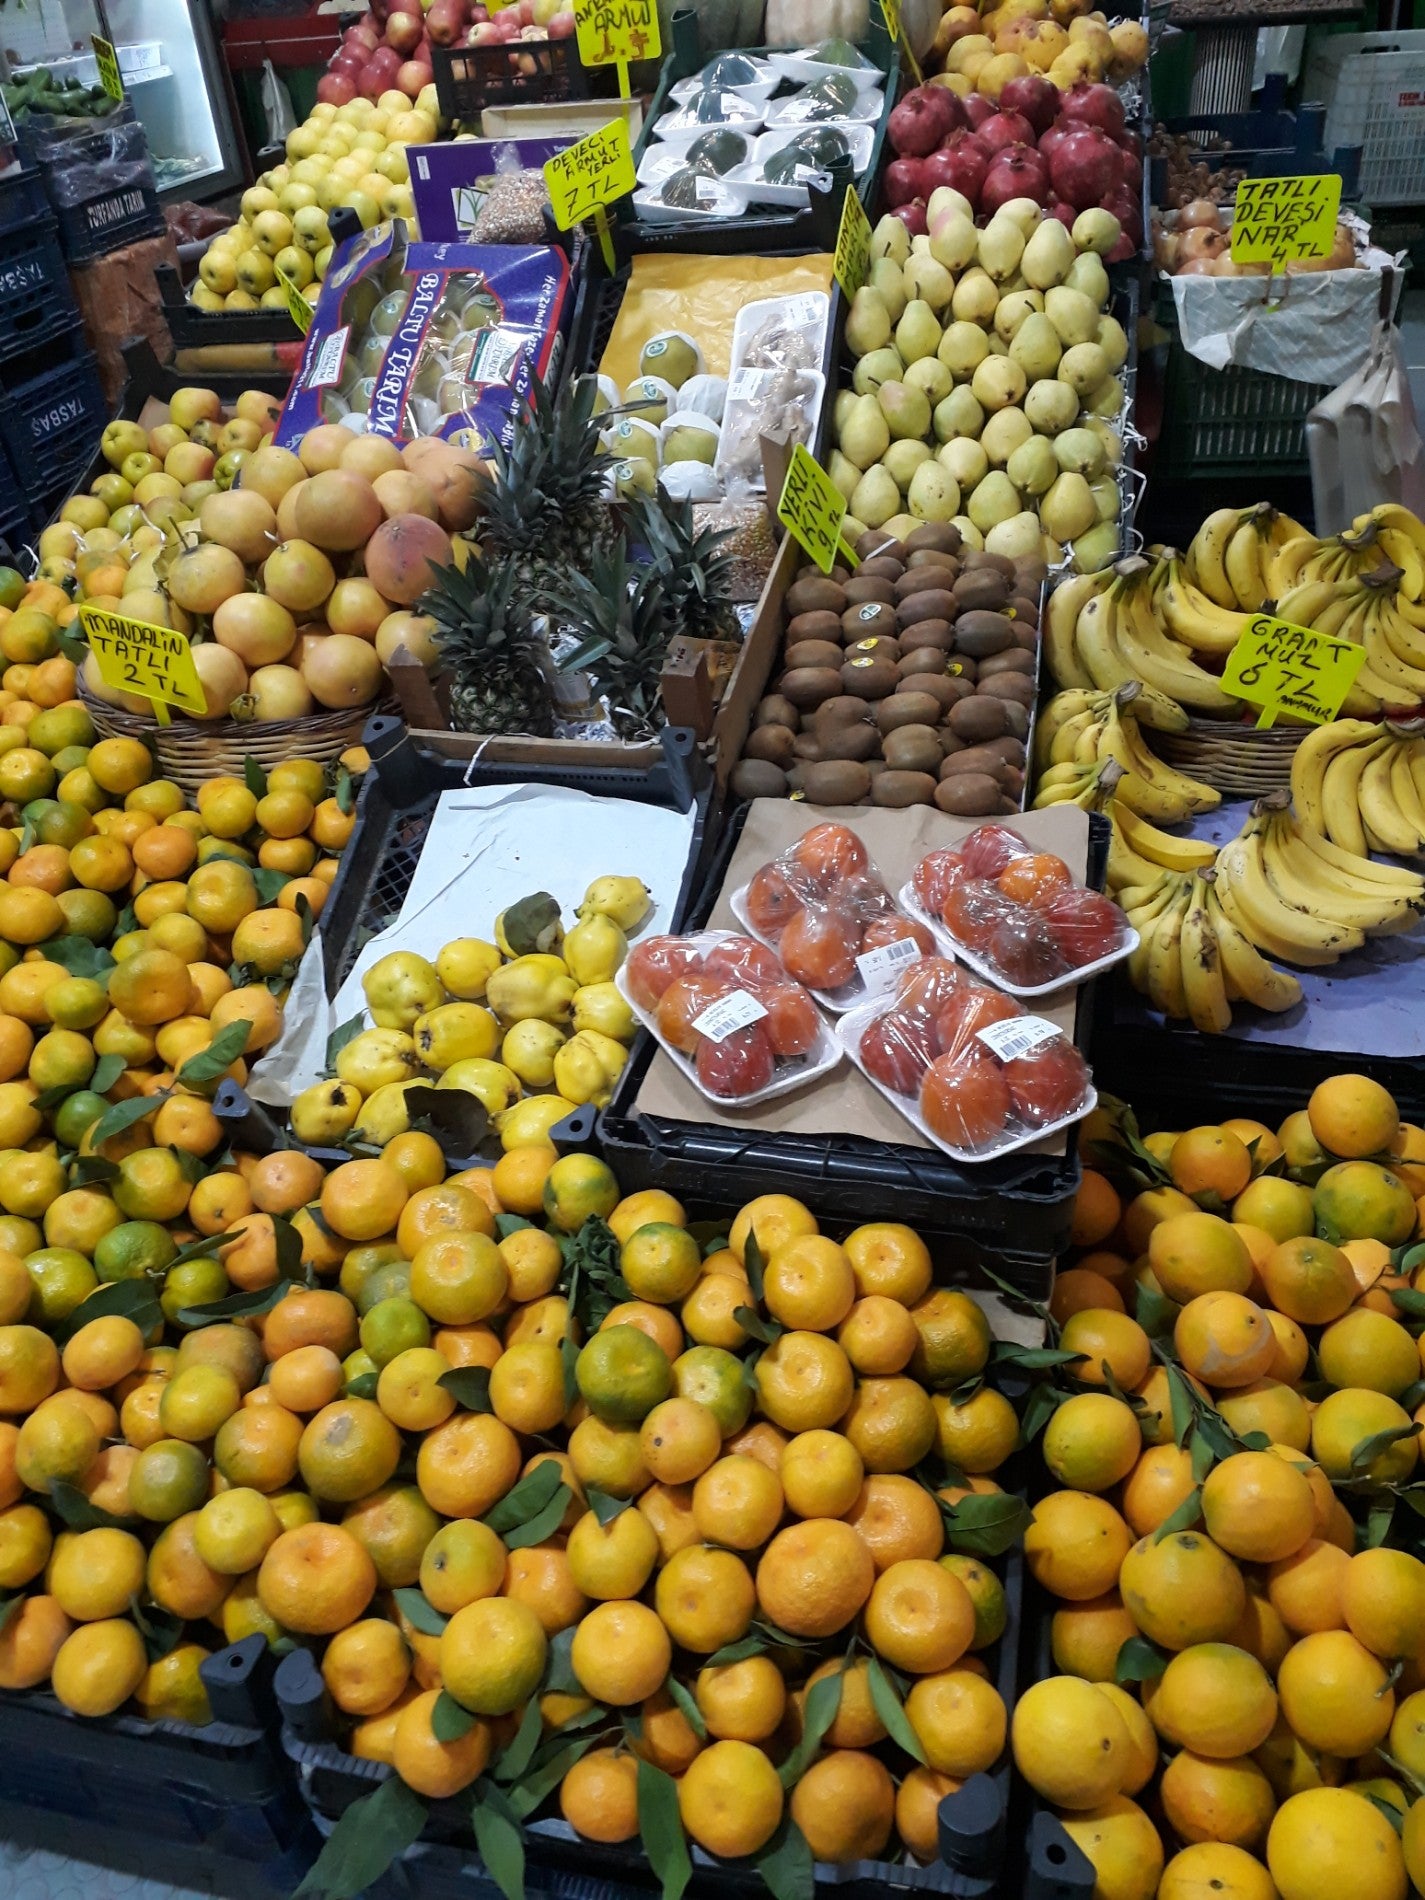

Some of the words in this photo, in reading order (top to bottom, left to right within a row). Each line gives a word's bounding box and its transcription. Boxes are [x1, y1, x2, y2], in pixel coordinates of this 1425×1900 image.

[566, 137, 619, 180] ARMUT
[564, 187, 578, 217] 7
[587, 175, 619, 199] TL
[1243, 180, 1321, 200] TATLI
[1236, 224, 1299, 246] NAR
[1271, 246, 1287, 263] 4
[1297, 243, 1324, 257] TL
[400, 273, 439, 342] BALTU
[375, 348, 412, 435] TARIM
[93, 636, 169, 671] TATLI
[1256, 643, 1320, 670] MUZ
[124, 664, 146, 685] 2
[152, 673, 189, 697] TL
[1276, 670, 1319, 702] TL
